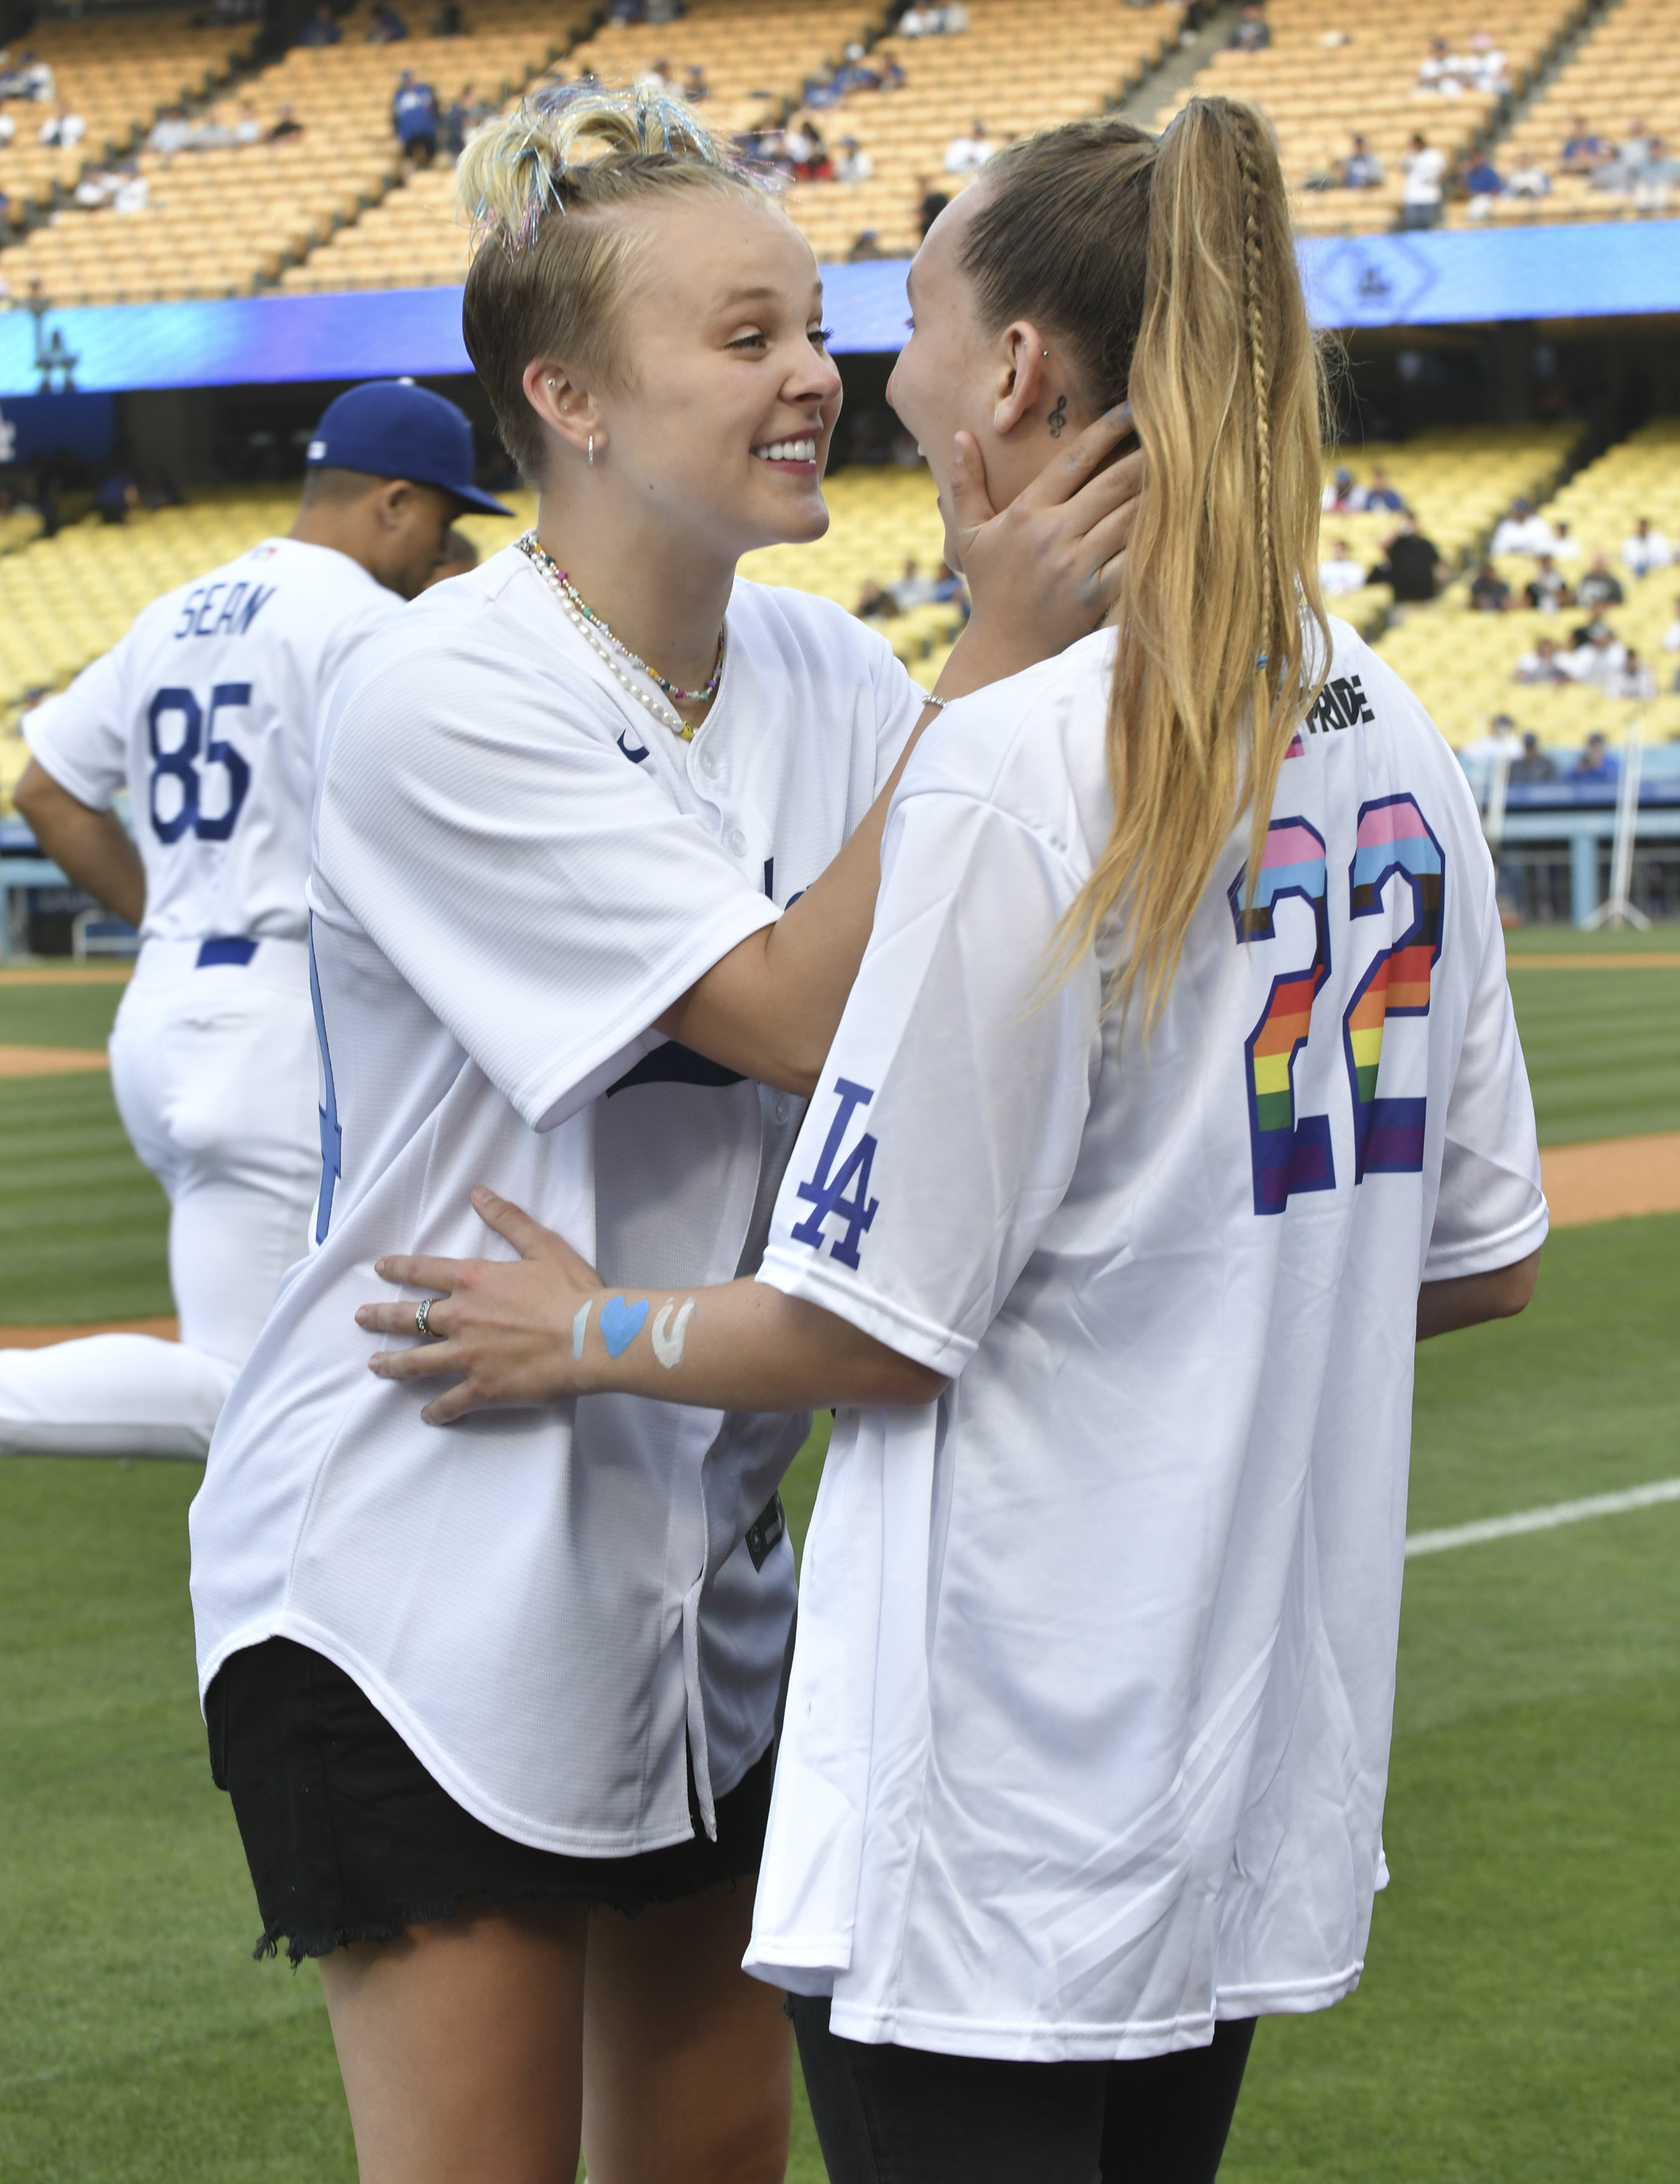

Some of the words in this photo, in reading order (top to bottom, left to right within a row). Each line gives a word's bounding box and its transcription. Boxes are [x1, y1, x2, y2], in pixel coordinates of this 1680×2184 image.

[174, 582, 277, 641] SEAN
[148, 682, 253, 847] 85
[1227, 792, 1446, 1216] 22
[790, 1077, 879, 1271] LA
[572, 1299, 593, 1364] I
[651, 1297, 695, 1369] U
